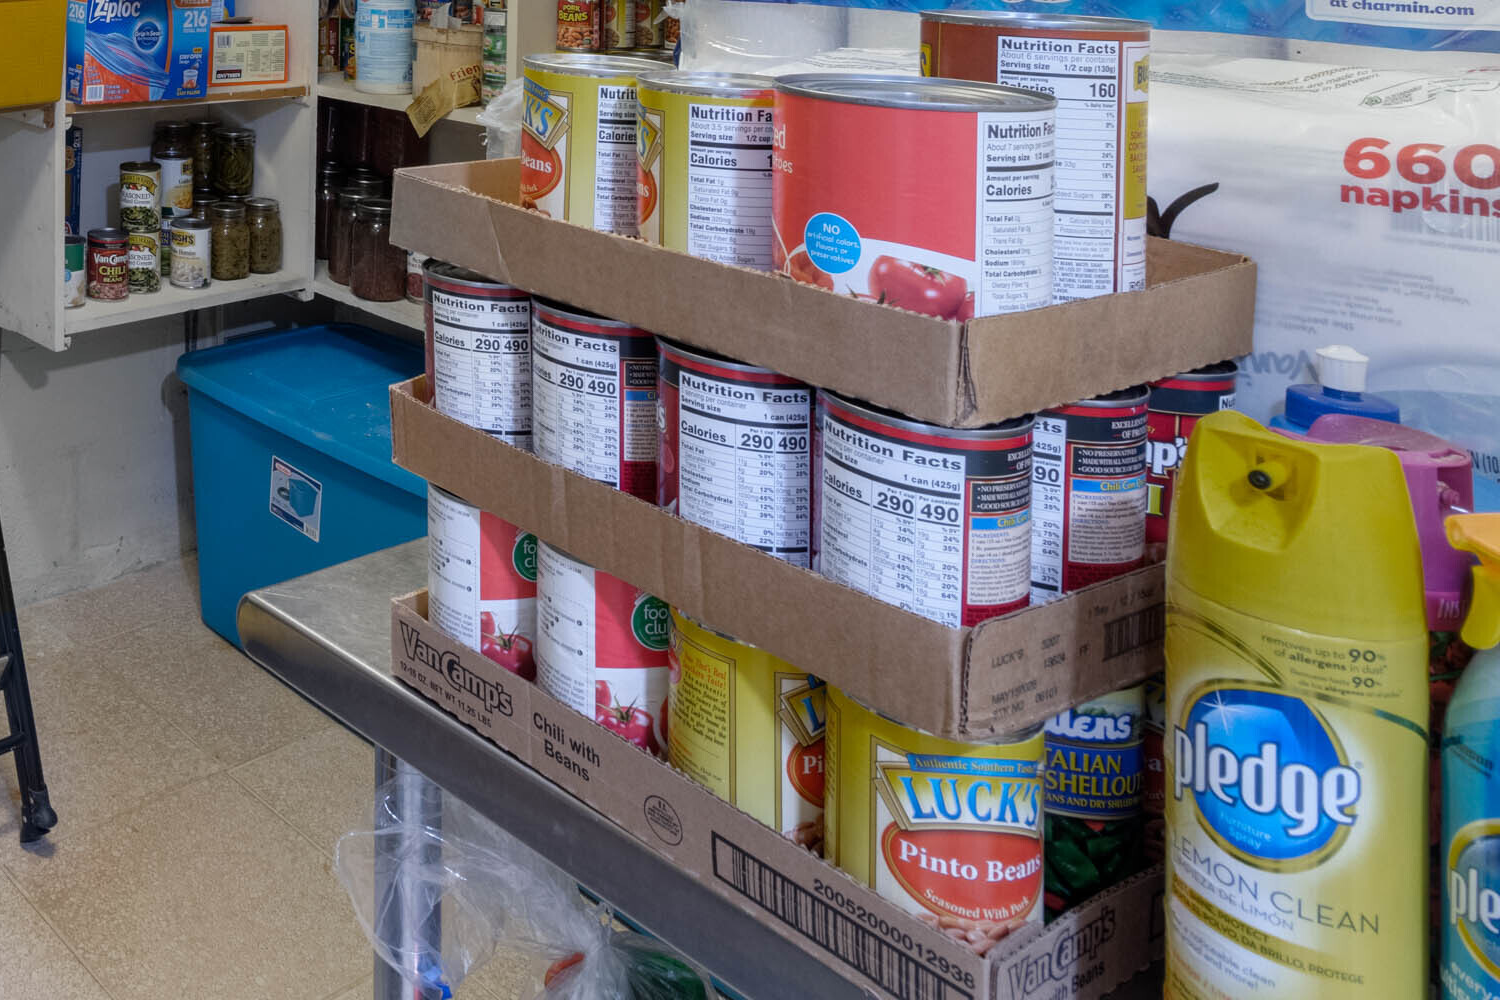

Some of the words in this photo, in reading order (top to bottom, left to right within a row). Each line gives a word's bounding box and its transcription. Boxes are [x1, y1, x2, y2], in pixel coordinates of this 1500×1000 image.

[69, 3, 86, 19] 216
[558, 10, 588, 22] BEANS
[563, 4, 581, 12] PORK
[183, 10, 209, 28] 216
[1001, 38, 1072, 54] Nutrition
[1078, 42, 1116, 55] Facts
[1000, 60, 1031, 71] Serving
[1033, 62, 1051, 71] size
[1063, 63, 1077, 73] 1/2
[1078, 65, 1092, 75] cup
[1033, 53, 1070, 64] servings
[600, 87, 637, 101] Nutriti
[1089, 83, 1117, 98] 160
[691, 106, 753, 122] Nutrition
[690, 131, 718, 142] Serving
[718, 133, 733, 142] size
[987, 124, 1042, 140] Nutrition
[690, 152, 738, 167] Calories
[986, 153, 1014, 164] Serving
[1342, 136, 1500, 191] 660
[986, 184, 1032, 197] Calories
[823, 224, 841, 235] NO
[99, 265, 126, 275] CHILI
[434, 293, 484, 311] Nutrition
[490, 303, 528, 313] Facts
[434, 330, 465, 347] Calories
[475, 338, 500, 351] 290
[504, 339, 529, 351] 490
[574, 339, 618, 353] Facts
[560, 372, 584, 390] 290
[588, 379, 616, 395] 490
[682, 375, 755, 400] Nutrition
[762, 391, 809, 404] Facts
[681, 420, 727, 443] Calories
[741, 433, 774, 450] 290
[778, 436, 807, 450] 490
[825, 420, 894, 458] Nutrition
[902, 449, 962, 471] Facts
[823, 468, 862, 499] Calories
[877, 491, 914, 515] 290
[920, 503, 959, 523] 490
[931, 479, 960, 492] (425g)
[1260, 634, 1311, 656] removes
[1314, 646, 1331, 660] up
[399, 619, 513, 717] VanCamp's
[991, 648, 1025, 669] LUCK'S
[1288, 652, 1347, 673] allergens
[430, 680, 444, 697] NET
[533, 712, 566, 745] Chili
[569, 737, 601, 768] with
[543, 738, 590, 782] Beans
[915, 757, 967, 771] Authentic
[971, 760, 1015, 773] Southern
[1044, 748, 1122, 775] TALIAN
[1045, 771, 1141, 798] SHELLOUT
[1173, 721, 1361, 837] pledge
[898, 775, 1041, 827] LUCK'S
[1220, 811, 1273, 841] Furniture
[1228, 824, 1263, 849] Spray
[898, 838, 979, 881] Pinto
[986, 854, 1041, 883] Beans
[1172, 831, 1259, 901] LEMON
[1270, 890, 1380, 936] CLEAN
[924, 888, 981, 919] Seasoned
[983, 905, 1009, 920] With
[1011, 896, 1030, 916] Pork
[813, 878, 976, 990] 20052000012938
[1307, 962, 1366, 986] PROTEGE
